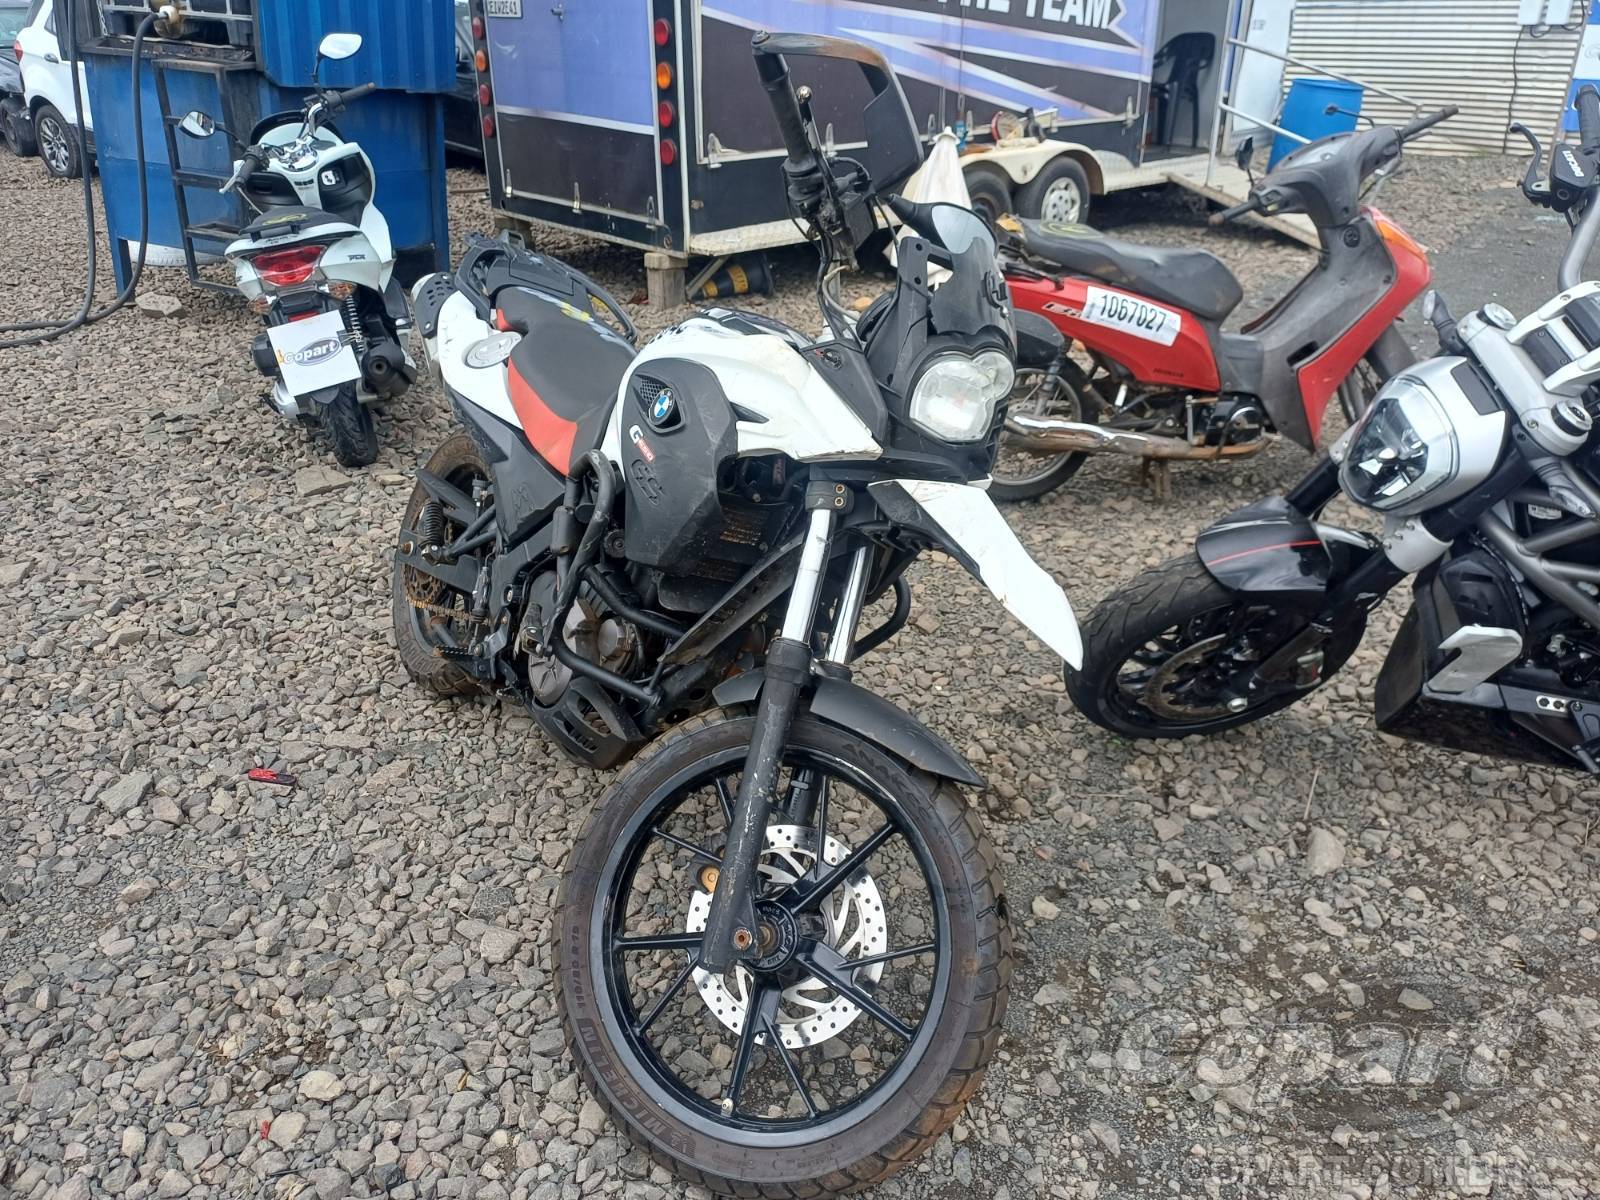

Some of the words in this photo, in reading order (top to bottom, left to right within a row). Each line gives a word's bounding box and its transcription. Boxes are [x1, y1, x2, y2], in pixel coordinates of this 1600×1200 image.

[1100, 294, 1167, 332] 1067027
[570, 959, 586, 1010] 110/80
[582, 1026, 664, 1136] MICHELIN
